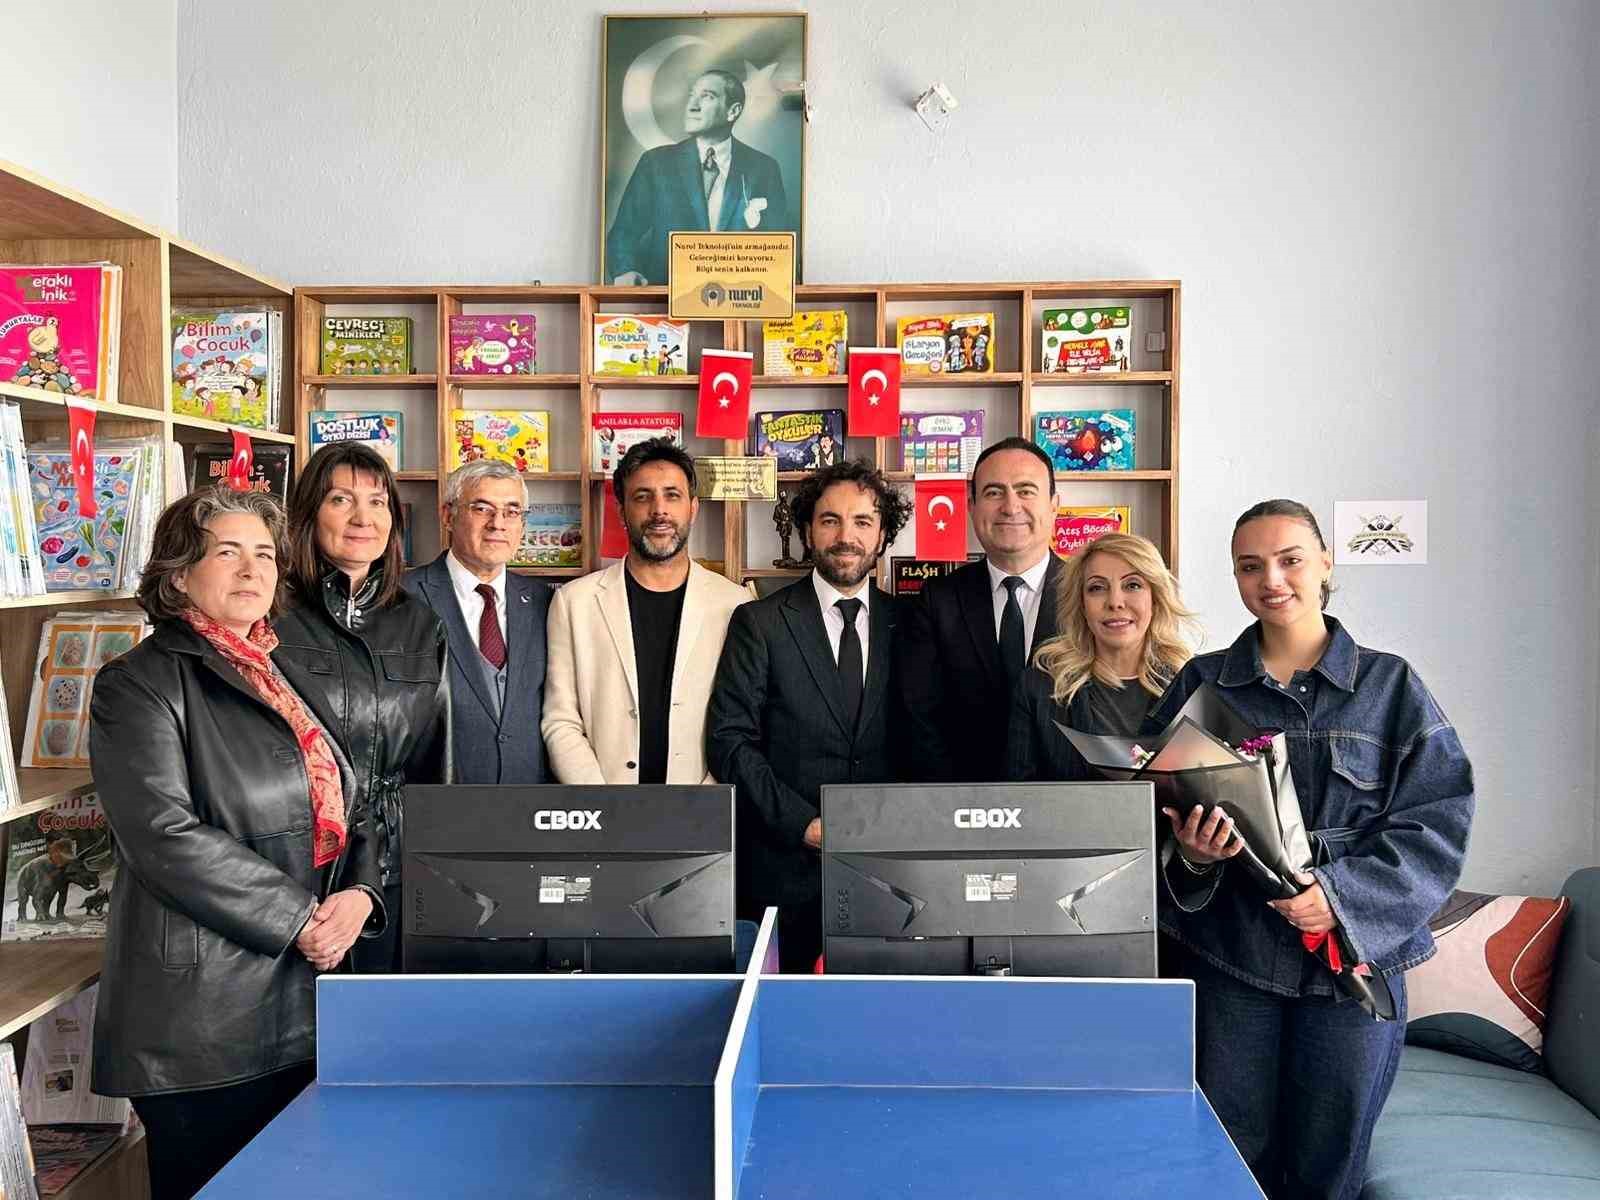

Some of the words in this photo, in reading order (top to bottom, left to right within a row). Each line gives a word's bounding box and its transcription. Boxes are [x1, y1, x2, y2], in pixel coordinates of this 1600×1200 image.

[675, 242, 696, 250] Nurol
[696, 265, 713, 274] Bilgi
[17, 273, 73, 287] eraklı
[25, 287, 68, 302] inik
[728, 284, 763, 301] nurol
[187, 321, 232, 337] Bilim
[196, 336, 251, 354] Çocuk
[316, 418, 380, 434] DOSTLUK
[902, 563, 938, 579] FLASH
[38, 809, 105, 833] Çocuk
[534, 809, 602, 831] CBOX
[954, 807, 1022, 829] CBOX
